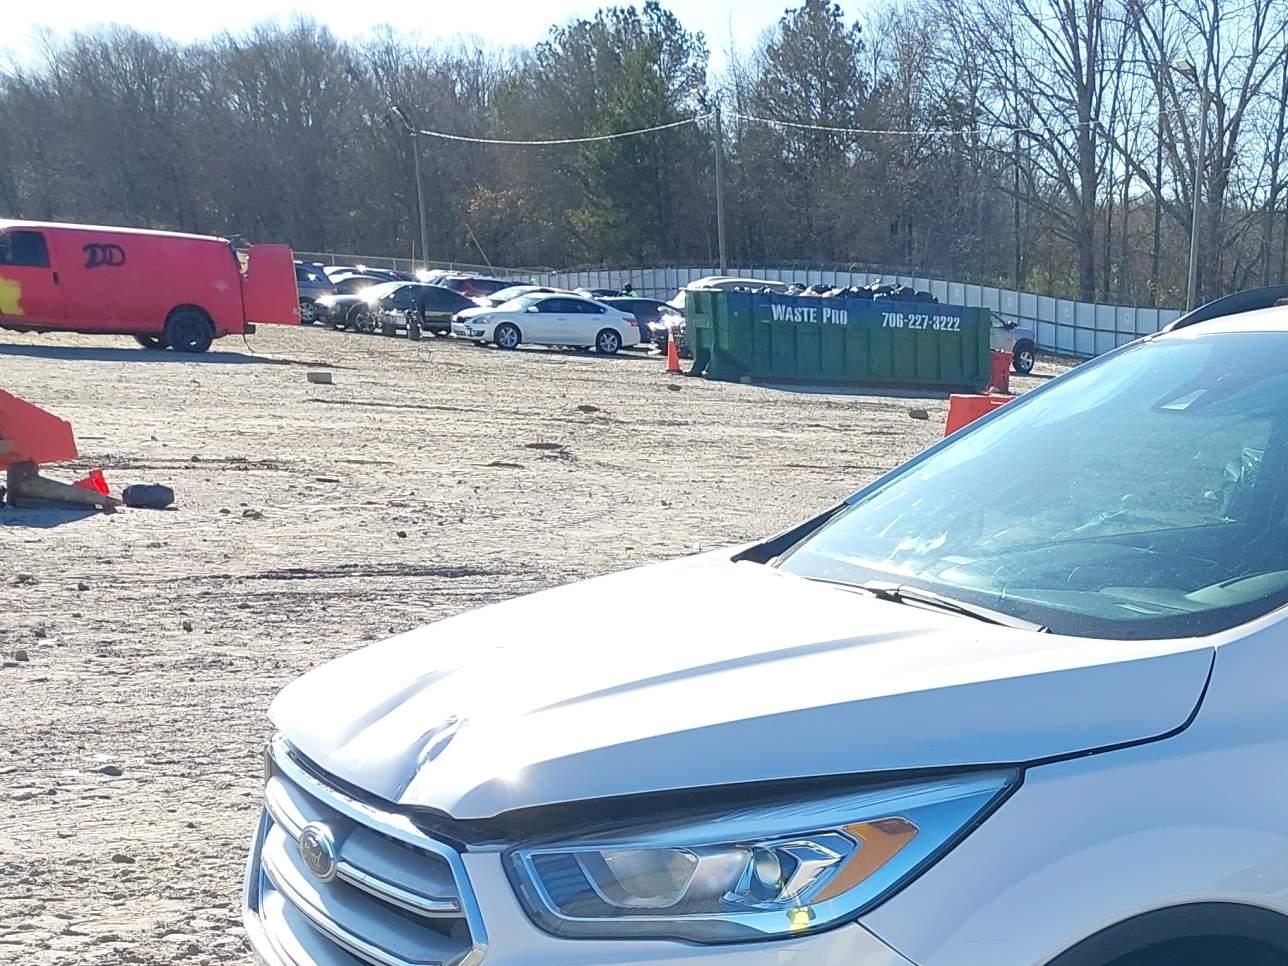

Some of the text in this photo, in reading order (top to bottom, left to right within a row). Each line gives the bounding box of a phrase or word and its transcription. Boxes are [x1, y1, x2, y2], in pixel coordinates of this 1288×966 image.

[772, 304, 848, 325] WASTE PRO
[882, 312, 960, 332] 706-227-3222
